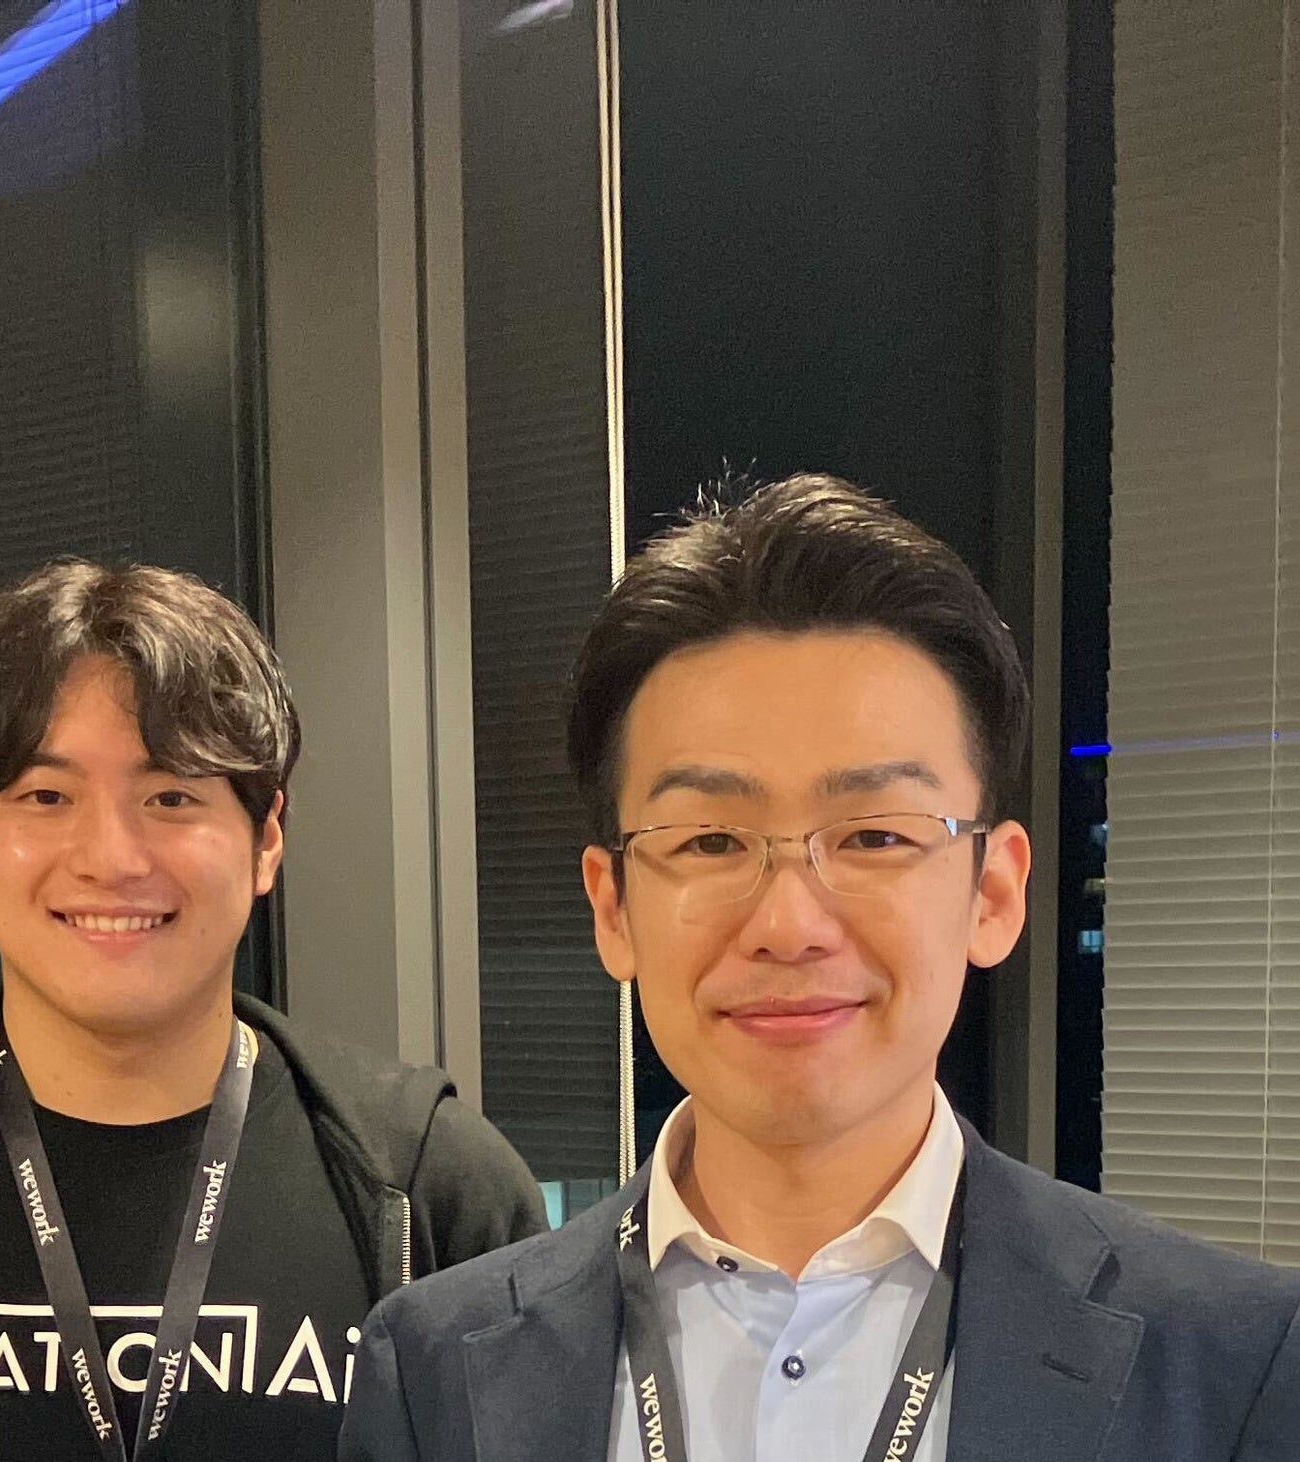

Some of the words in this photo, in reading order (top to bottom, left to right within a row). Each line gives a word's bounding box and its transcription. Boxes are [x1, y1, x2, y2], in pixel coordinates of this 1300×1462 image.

[18, 1158, 60, 1246] wework
[194, 1159, 227, 1246] wework
[71, 1347, 113, 1440] wework
[147, 1348, 183, 1441] wework
[265, 1315, 361, 1404] Ai
